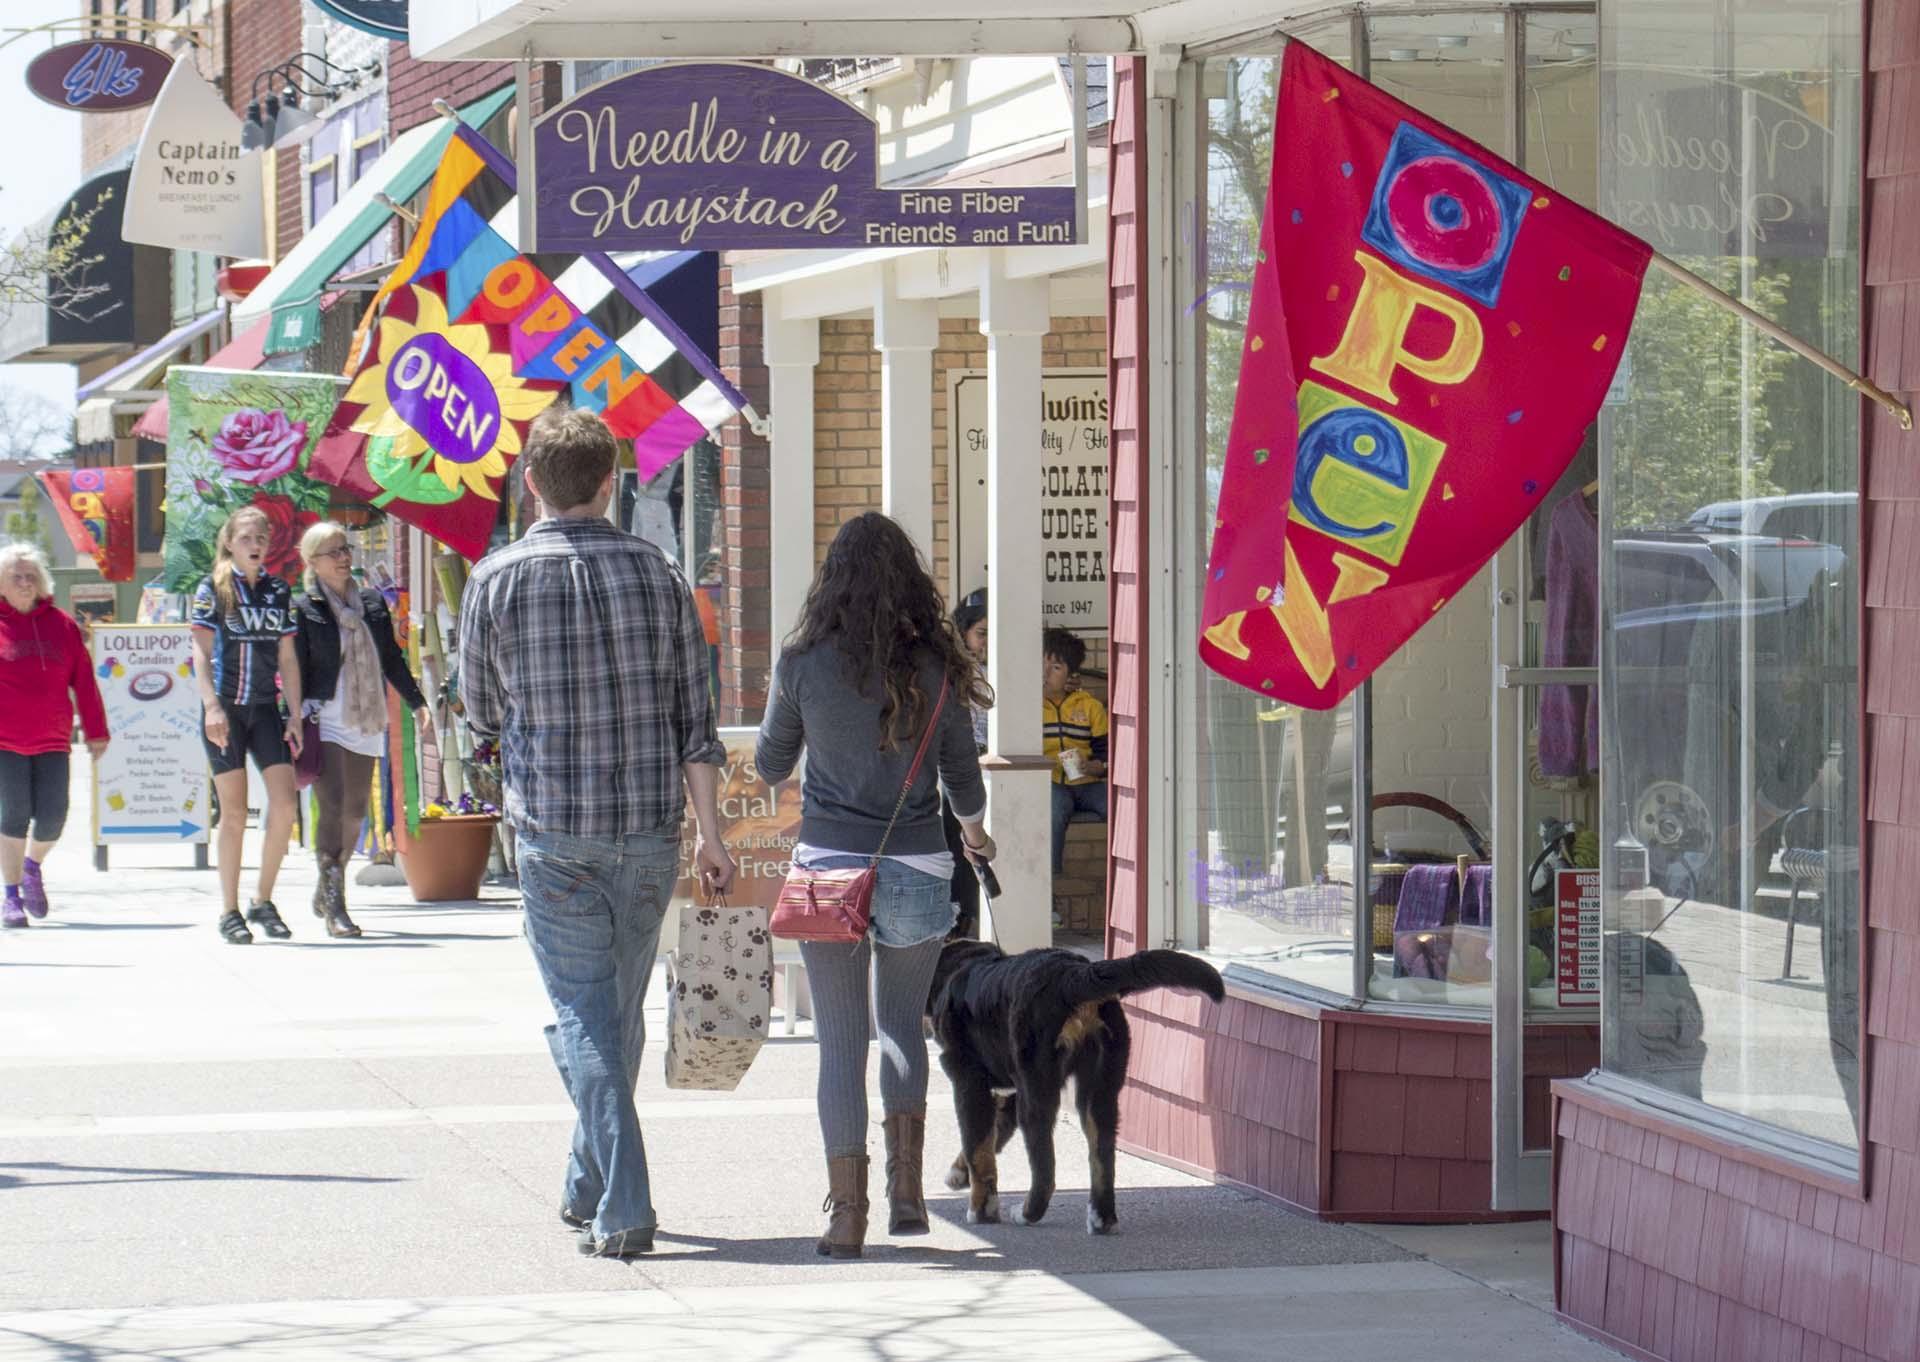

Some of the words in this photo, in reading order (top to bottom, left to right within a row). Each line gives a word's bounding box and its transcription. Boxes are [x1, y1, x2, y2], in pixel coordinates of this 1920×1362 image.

[63, 44, 144, 106] Elks
[556, 96, 746, 174] Needle
[758, 114, 810, 163] in
[821, 138, 857, 173] a
[158, 139, 240, 164] Captain
[161, 165, 236, 186] Nemo's
[569, 174, 847, 244] Haystack
[900, 192, 953, 214] Fine
[960, 191, 1025, 214] Fiber
[865, 221, 957, 244] Friends
[972, 224, 1010, 243] and
[1017, 220, 1071, 243] Fun!
[483, 260, 643, 401] OPEN
[394, 346, 494, 452] OPEN
[966, 428, 988, 451] Fi
[1042, 465, 1108, 497] OLAT
[1042, 507, 1097, 539] UDGE
[1070, 600, 1092, 614] 1947
[128, 652, 175, 665] Candies
[717, 786, 777, 819] cial
[739, 856, 792, 879] Free
[1580, 927, 1599, 935] 11:00
